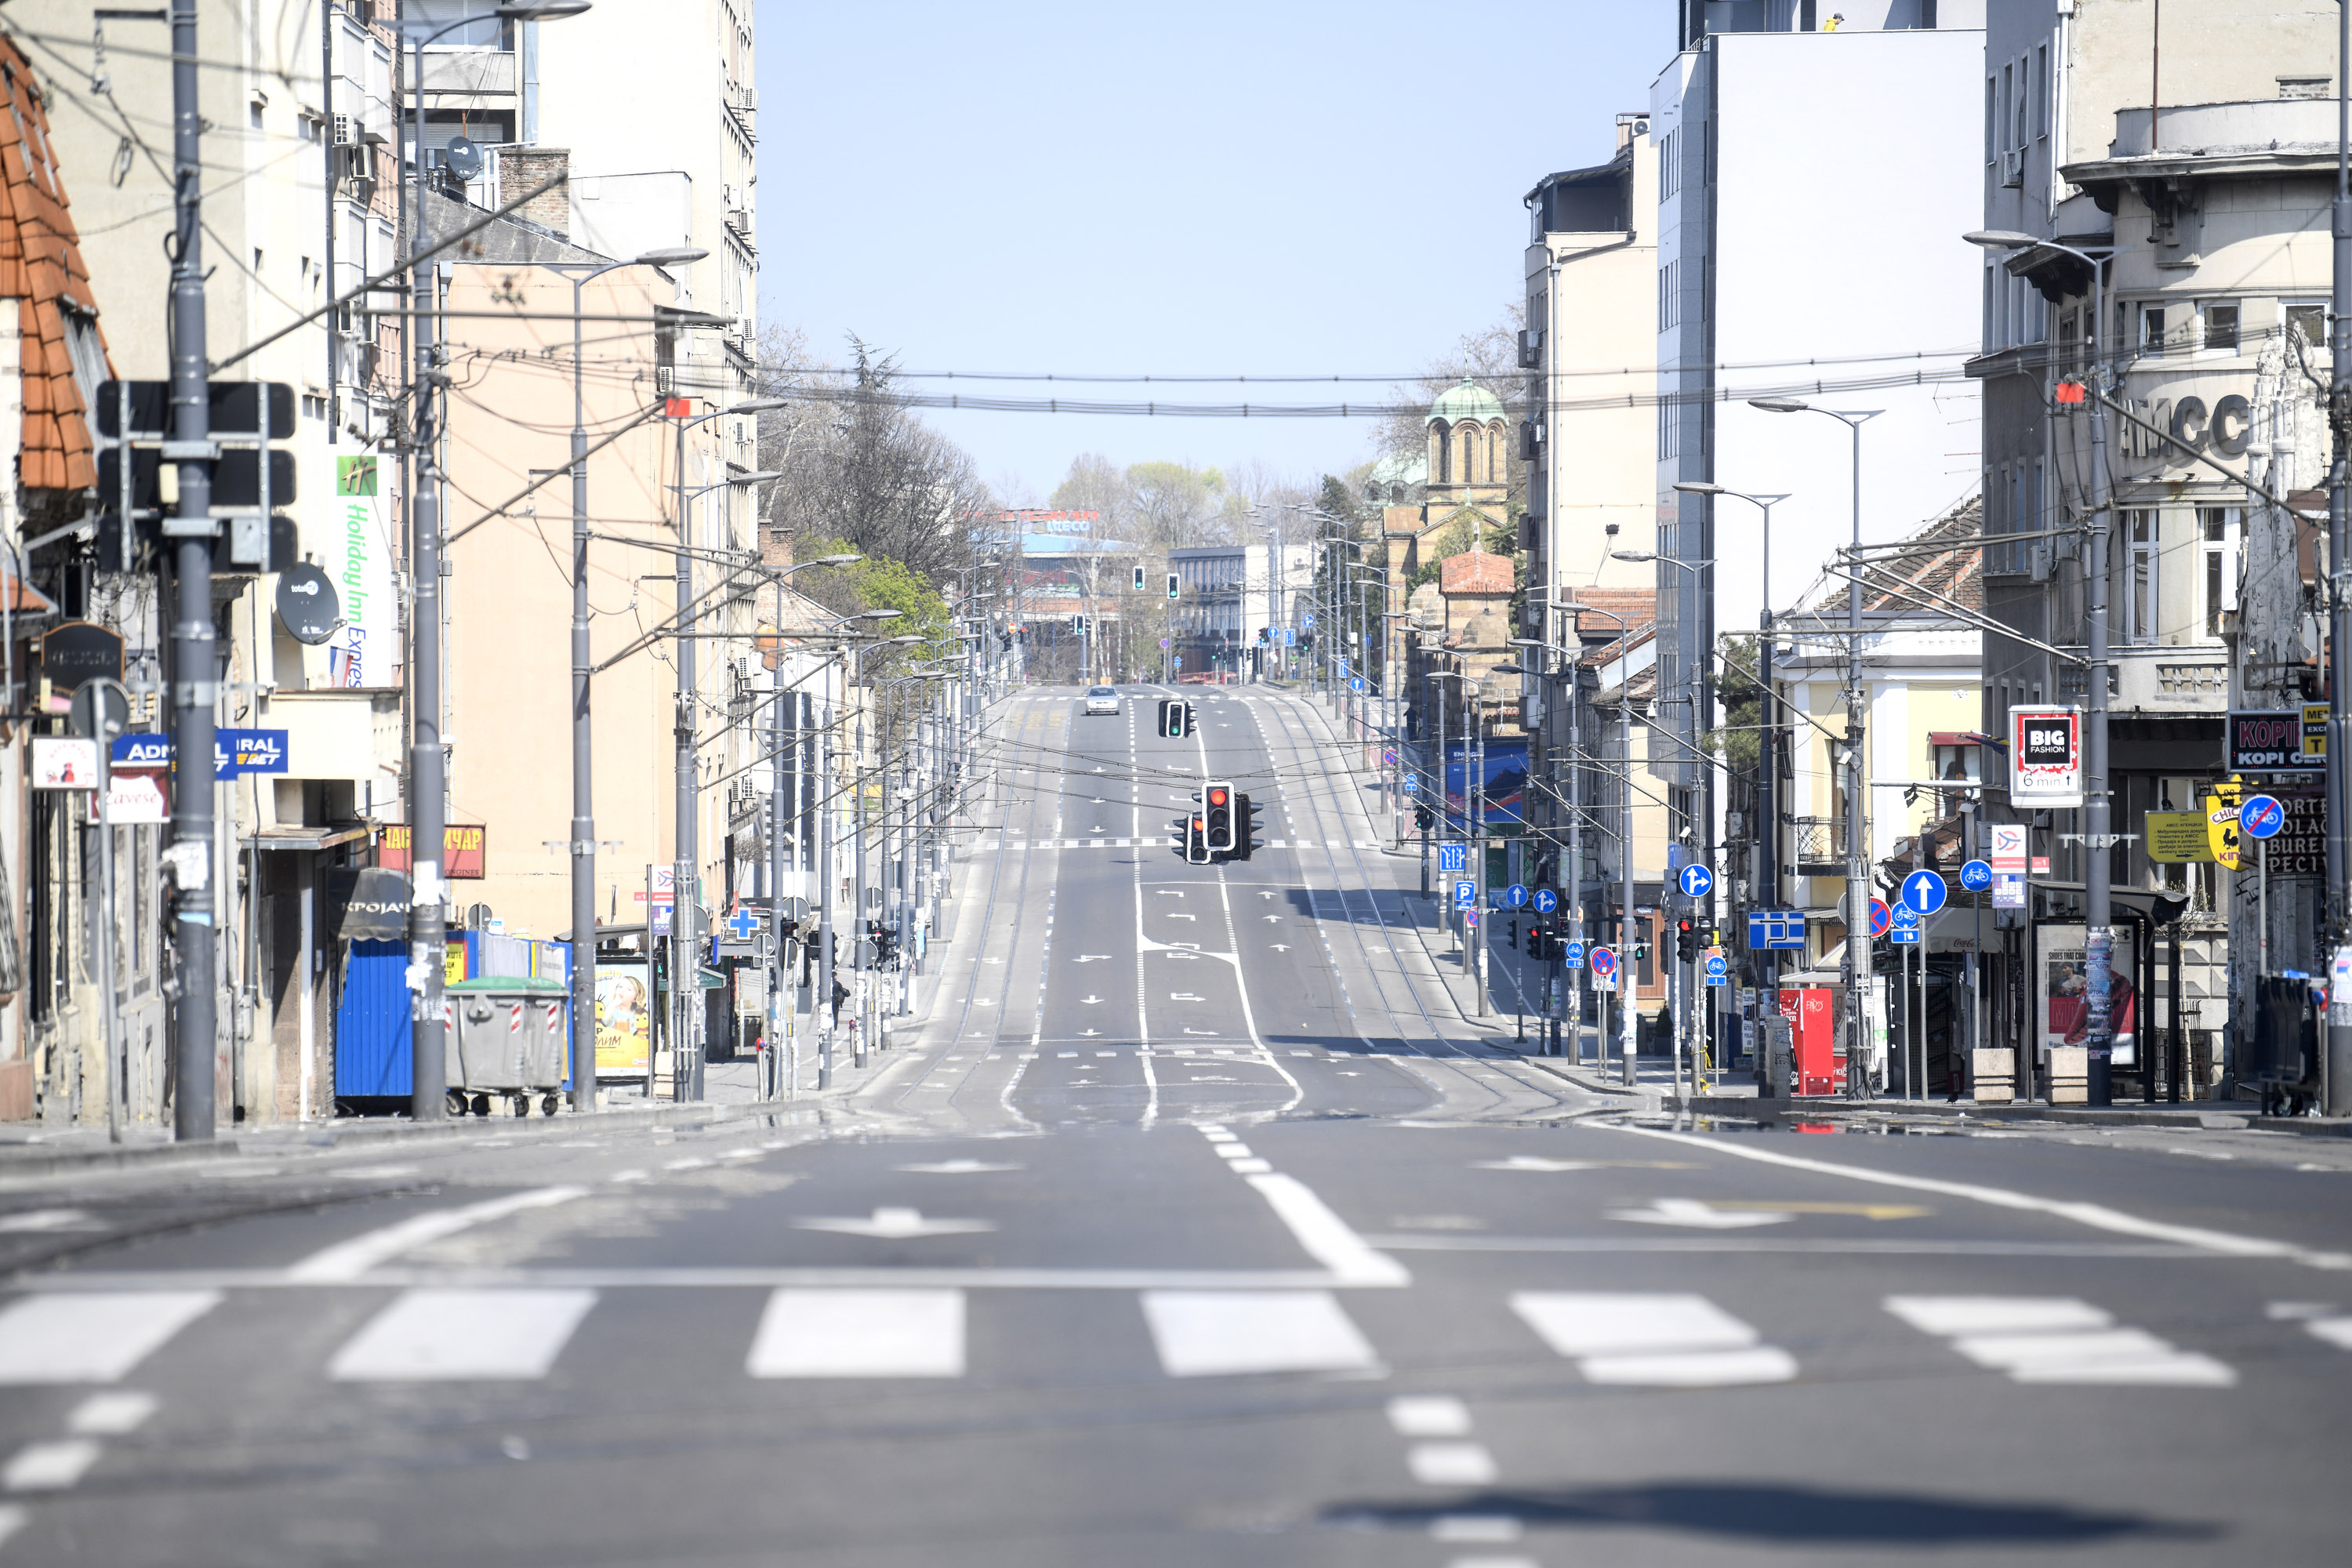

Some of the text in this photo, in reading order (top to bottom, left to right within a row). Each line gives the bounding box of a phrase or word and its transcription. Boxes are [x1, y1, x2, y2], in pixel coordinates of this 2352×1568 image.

[1047, 521, 1091, 532] IVECO
[343, 503, 368, 590] Holiday
[347, 590, 368, 622] Inn
[2030, 730, 2065, 746] BIG
[2238, 752, 2285, 765] KOPI
[2024, 773, 2033, 786] 6
[1460, 887, 1470, 899] P
[2049, 952, 2063, 960] SHOES
[2063, 952, 2074, 960] THAT
